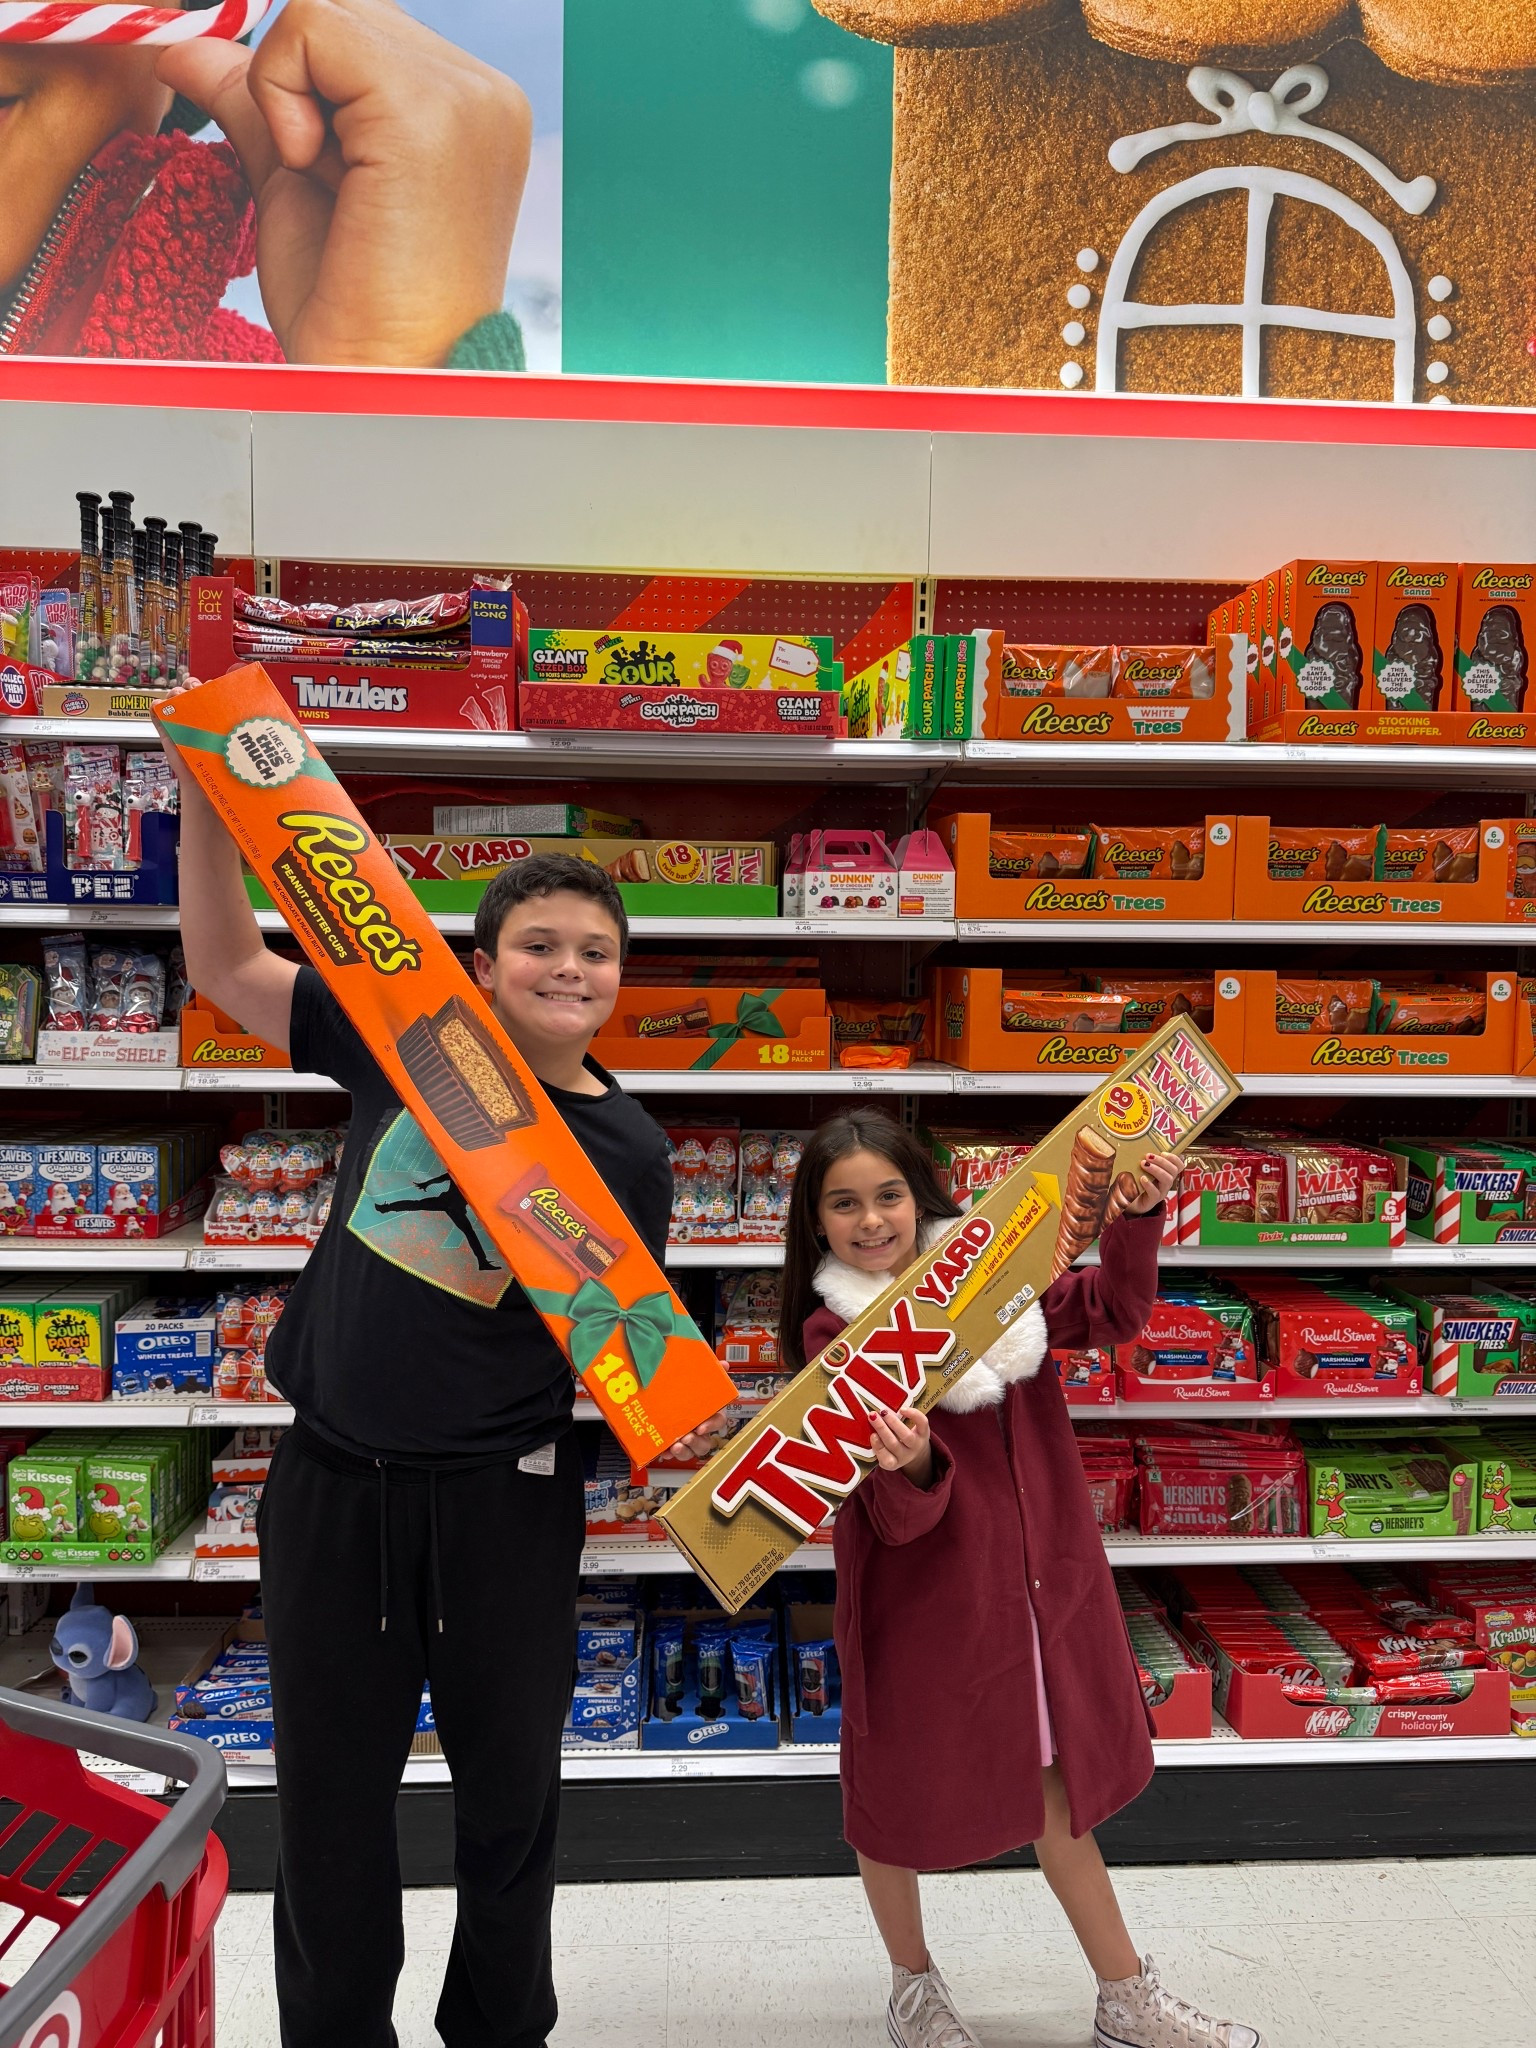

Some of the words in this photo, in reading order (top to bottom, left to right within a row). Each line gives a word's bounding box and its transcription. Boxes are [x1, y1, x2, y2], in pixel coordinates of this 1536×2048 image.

[1306, 565, 1367, 586] Reese's
[1387, 566, 1447, 588] Reese's
[1472, 567, 1533, 590] Reese's
[198, 587, 223, 600] low
[1323, 587, 1350, 595] santa
[1404, 588, 1431, 596] santa
[1489, 590, 1516, 598] santa
[197, 600, 222, 613] fat
[473, 601, 508, 610] EXTRA
[474, 610, 507, 620] LONG
[197, 613, 222, 621] snack
[473, 649, 509, 659] strawberry
[533, 650, 588, 664] GIANT
[925, 640, 935, 661] Kids
[957, 640, 967, 662] Kids
[535, 664, 564, 672] SIZED
[566, 664, 587, 672] BOX
[604, 660, 674, 685] SOUR
[1124, 659, 1184, 680] Reese's
[923, 663, 935, 700] PATCH
[955, 663, 966, 700] PATCH
[291, 675, 408, 712] Twizzlers
[643, 703, 678, 717] SOUR
[679, 704, 717, 717] PATCH
[777, 698, 821, 709] GIANT
[1141, 709, 1175, 717] WHITE
[298, 710, 330, 719] TWISTS
[923, 701, 933, 734] SOUR
[954, 701, 964, 734] SOUR
[1021, 702, 1114, 735] Reese's
[1378, 717, 1430, 726] STOCKING
[1133, 720, 1182, 735] Trees
[1298, 714, 1359, 738] Reese's
[1366, 727, 1442, 736] OVERSTUFFER.
[1467, 718, 1528, 739] Reese's
[268, 730, 285, 748] LIKE
[280, 747, 295, 765] YOU
[450, 839, 532, 869] YARD
[662, 843, 692, 866] 18
[1104, 843, 1165, 864] Reese's
[72, 875, 134, 898] PEZ
[829, 874, 875, 884] DUNKIN'
[277, 810, 423, 975] Reese's
[1025, 882, 1111, 911] Reese's
[1112, 895, 1166, 911] Trees
[1302, 885, 1388, 914] Reese's
[1389, 898, 1441, 913] Trees
[272, 880, 281, 892] MILK
[279, 890, 299, 919] CHOCOLATE
[299, 921, 313, 941] PEANUT
[311, 939, 325, 958] BUTTER
[281, 863, 309, 898] PEANUT
[305, 899, 331, 935] BUTTER
[328, 934, 347, 958] CUPS
[638, 1013, 683, 1033] Reese's
[1397, 1009, 1407, 1019] 6
[48, 1049, 61, 1057] the
[62, 1047, 91, 1061] ELF
[116, 1049, 166, 1062] SHELF
[192, 1040, 266, 1063] Reese's
[758, 1045, 790, 1064] 18
[1037, 1036, 1121, 1065] Reese's
[1311, 1038, 1396, 1066] Reese's
[1397, 1050, 1448, 1066] Trees
[1104, 1086, 1134, 1119] 18
[1136, 1088, 1150, 1117] packs
[1113, 1121, 1132, 1130] twin
[1134, 1117, 1146, 1128] bar
[59, 1151, 91, 1163] SAVERS
[47, 1165, 84, 1173] GUMMIES
[1484, 1191, 1511, 1200] TREES
[529, 1187, 588, 1239] Reese's
[1383, 1199, 1399, 1217] 6
[988, 1256, 999, 1274] yard
[998, 1248, 1005, 1259] of
[1018, 1199, 1042, 1230] bars!
[1297, 1233, 1341, 1242] SNOWMEN
[914, 1216, 995, 1307] YARD
[48, 1324, 88, 1338] SOUR
[144, 1323, 157, 1331] 20
[158, 1322, 184, 1330] PACKS
[1141, 1325, 1176, 1343] Russell
[1177, 1324, 1212, 1340] Stover
[1301, 1327, 1339, 1345] Russell
[1339, 1326, 1376, 1342] Stover
[1443, 1322, 1512, 1340] SNICKERS
[47, 1336, 90, 1350] PATCH
[137, 1335, 191, 1350] OREO
[1479, 1340, 1506, 1350] TREES
[942, 1358, 961, 1377] cookie
[956, 1348, 970, 1363] bars
[593, 1352, 638, 1404] 18
[923, 1390, 941, 1409] caramel
[943, 1377, 953, 1390] milk
[952, 1355, 975, 1378] chocolate
[43, 1384, 80, 1392] CHRISTMAS
[1497, 1383, 1536, 1394] SNICKE
[621, 1405, 645, 1437] PACKS
[630, 1399, 664, 1447] FULL-SIZE
[1163, 1485, 1226, 1505] HERSHEY'S
[1163, 1511, 1228, 1525] santas
[1385, 1517, 1424, 1529] HERSHEY'S
[588, 1637, 624, 1649] OREO
[1488, 1627, 1536, 1648] Krabby
[220, 1698, 266, 1717] OREO
[583, 1704, 621, 1717] OREO
[1388, 1710, 1417, 1720] crispy
[1418, 1713, 1447, 1722] creamy
[688, 1723, 729, 1743] OREO
[1401, 1722, 1437, 1732] holiday
[1439, 1722, 1454, 1732] joy
